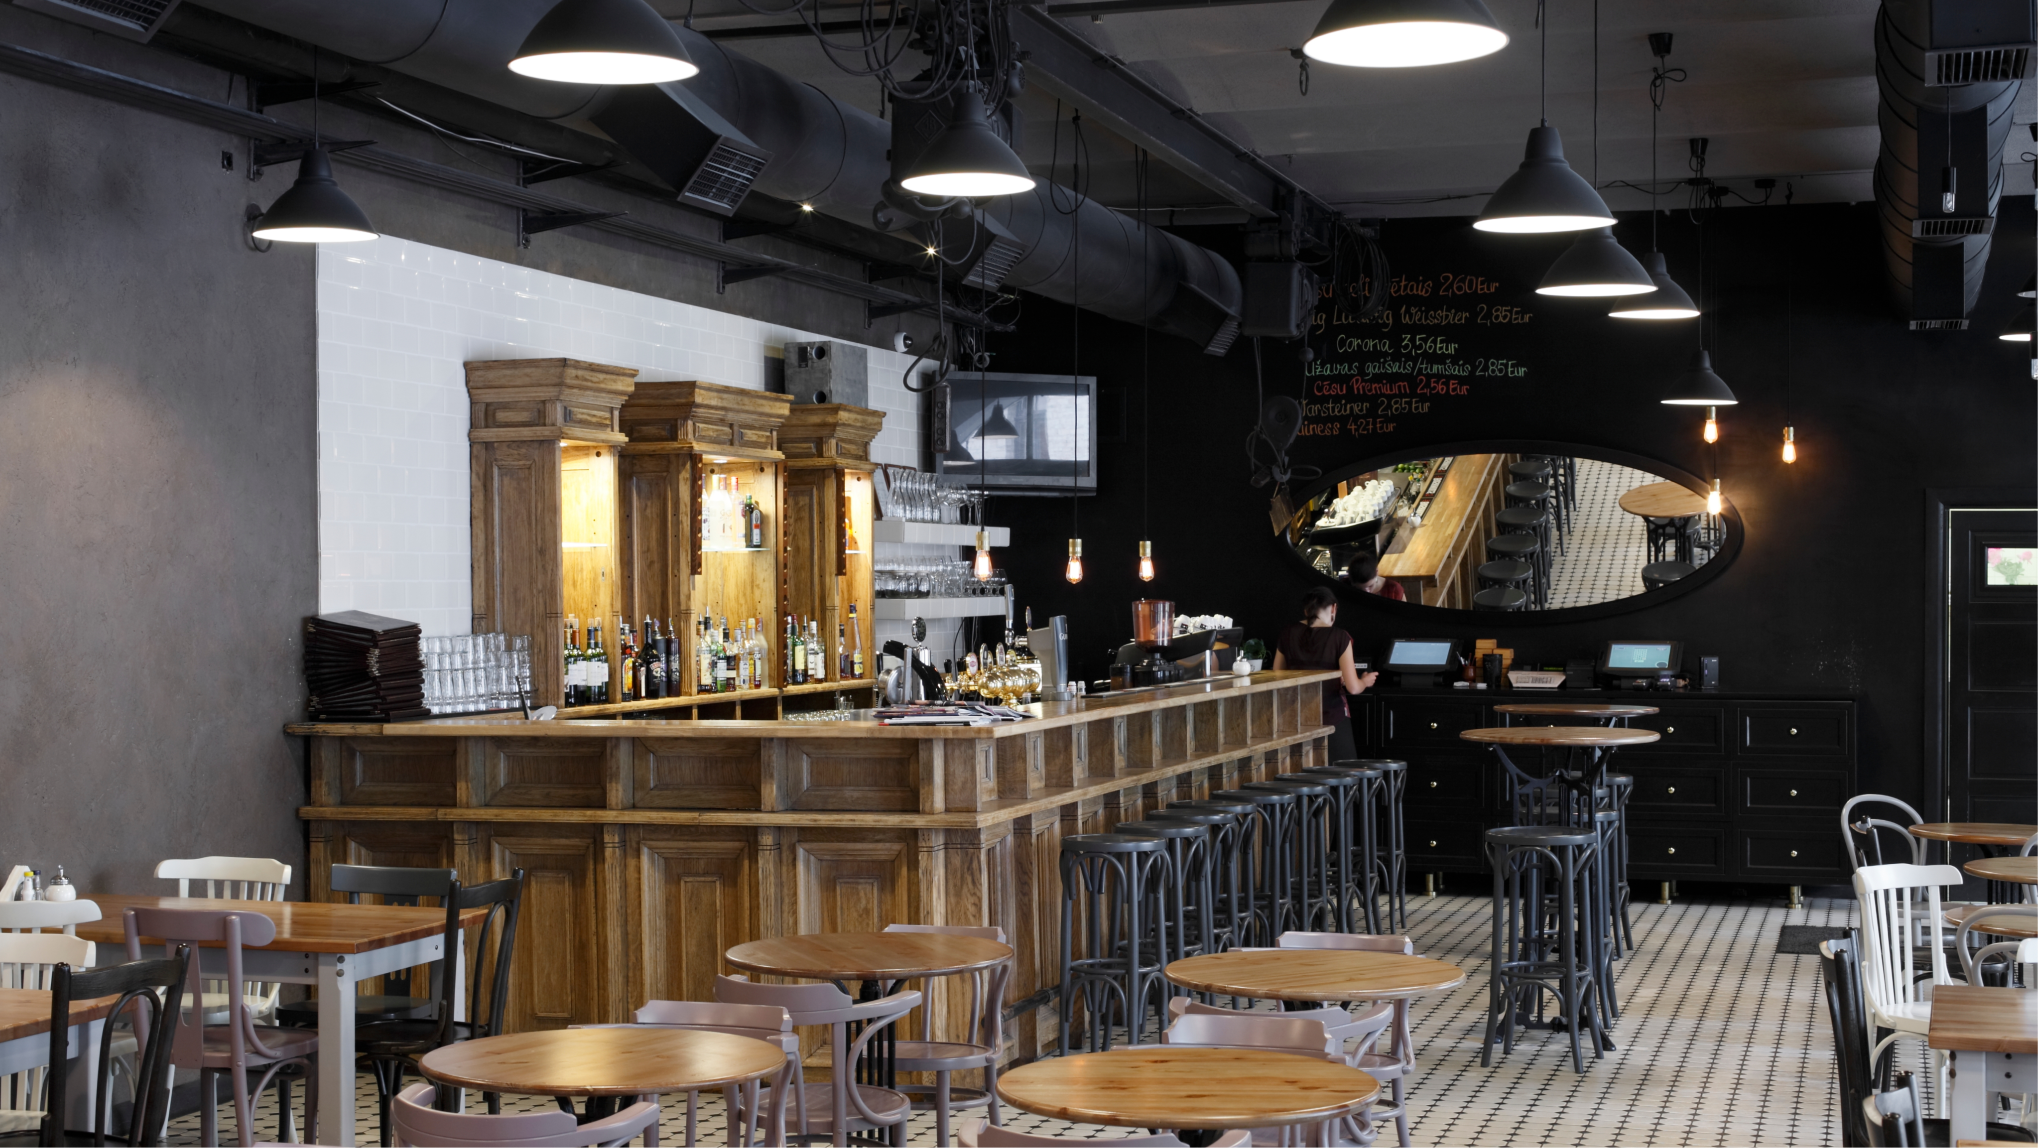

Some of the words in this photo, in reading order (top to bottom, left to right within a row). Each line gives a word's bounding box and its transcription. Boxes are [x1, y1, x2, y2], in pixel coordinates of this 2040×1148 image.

[1399, 304, 1470, 326] Weissbier
[1336, 334, 1395, 353] Corona
[1313, 380, 1347, 396] Cēsu
[1349, 375, 1410, 395] Premium
[1297, 420, 1341, 436] uiness
